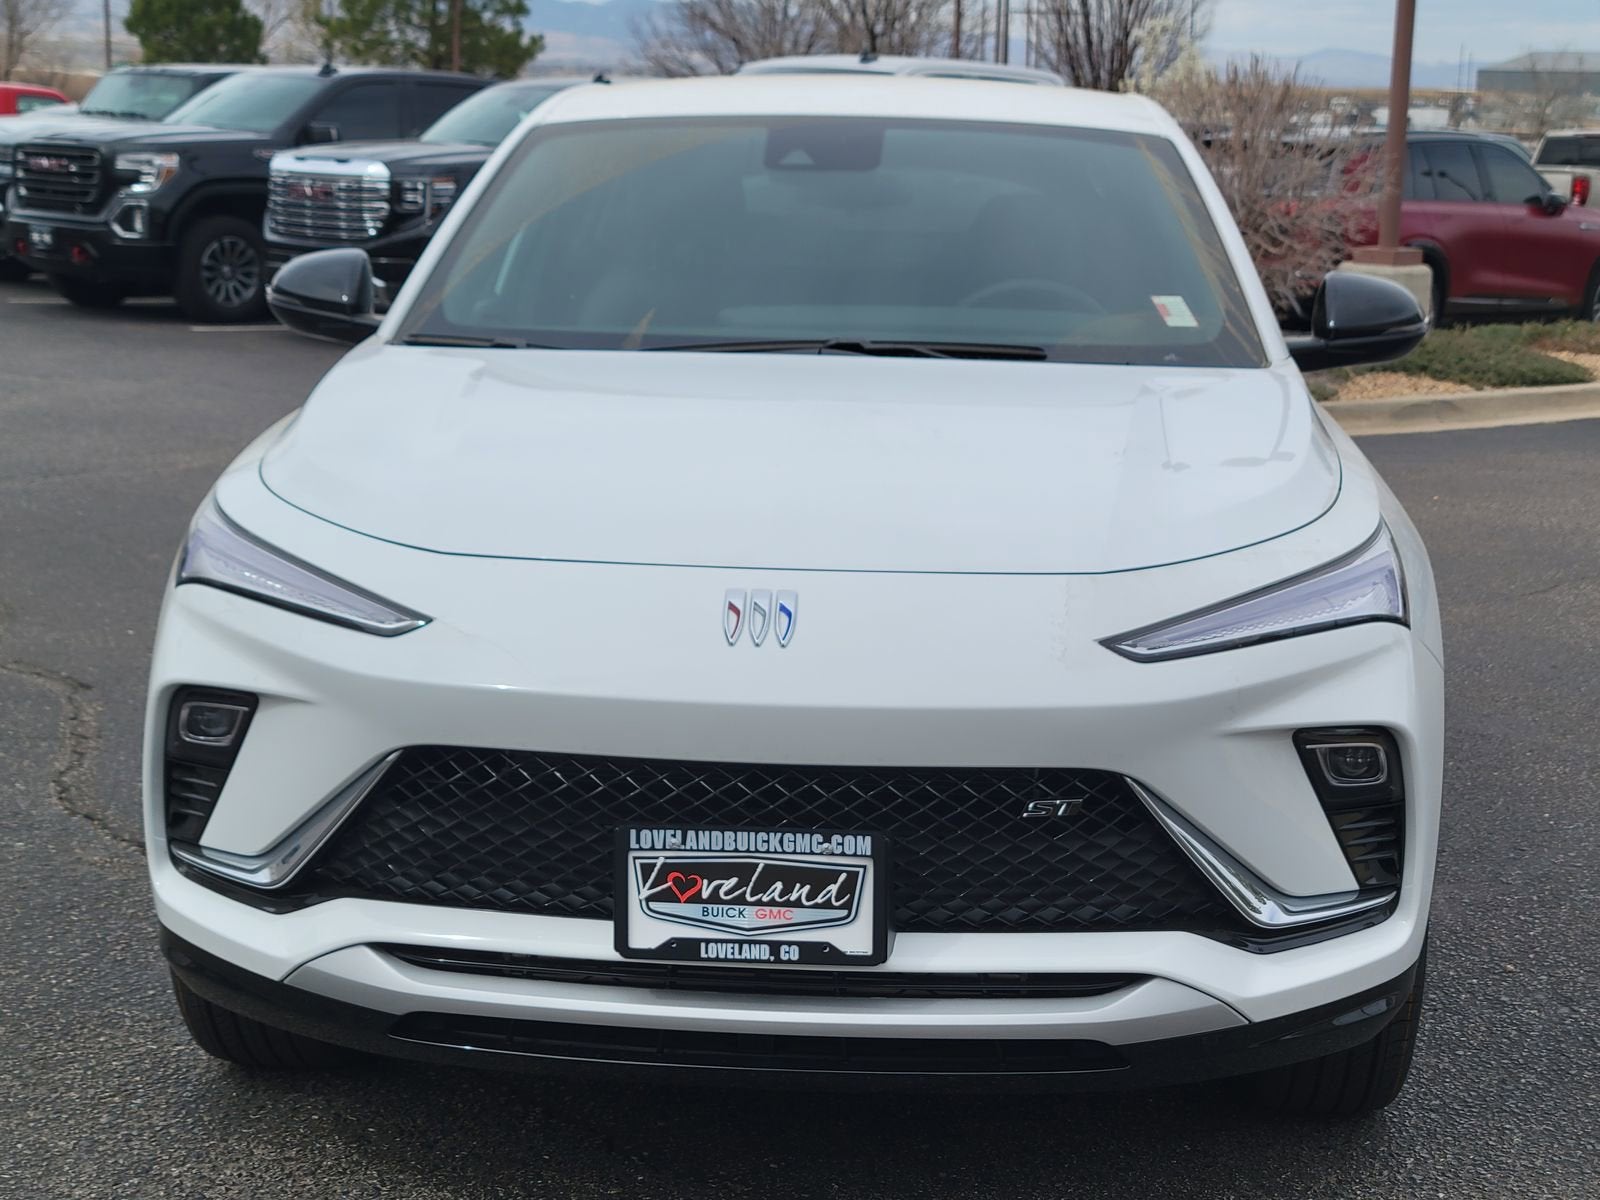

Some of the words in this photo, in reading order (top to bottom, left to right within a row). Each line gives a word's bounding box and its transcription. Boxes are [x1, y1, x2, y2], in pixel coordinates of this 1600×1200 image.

[1022, 799, 1083, 817] ST
[629, 829, 872, 856] LOVELANDBUICKGMCCOM
[638, 856, 850, 907] Loveland
[701, 906, 747, 919] BUICK
[755, 908, 794, 921] GMC
[700, 942, 775, 962] LOVELAND,
[780, 944, 800, 961] CO
